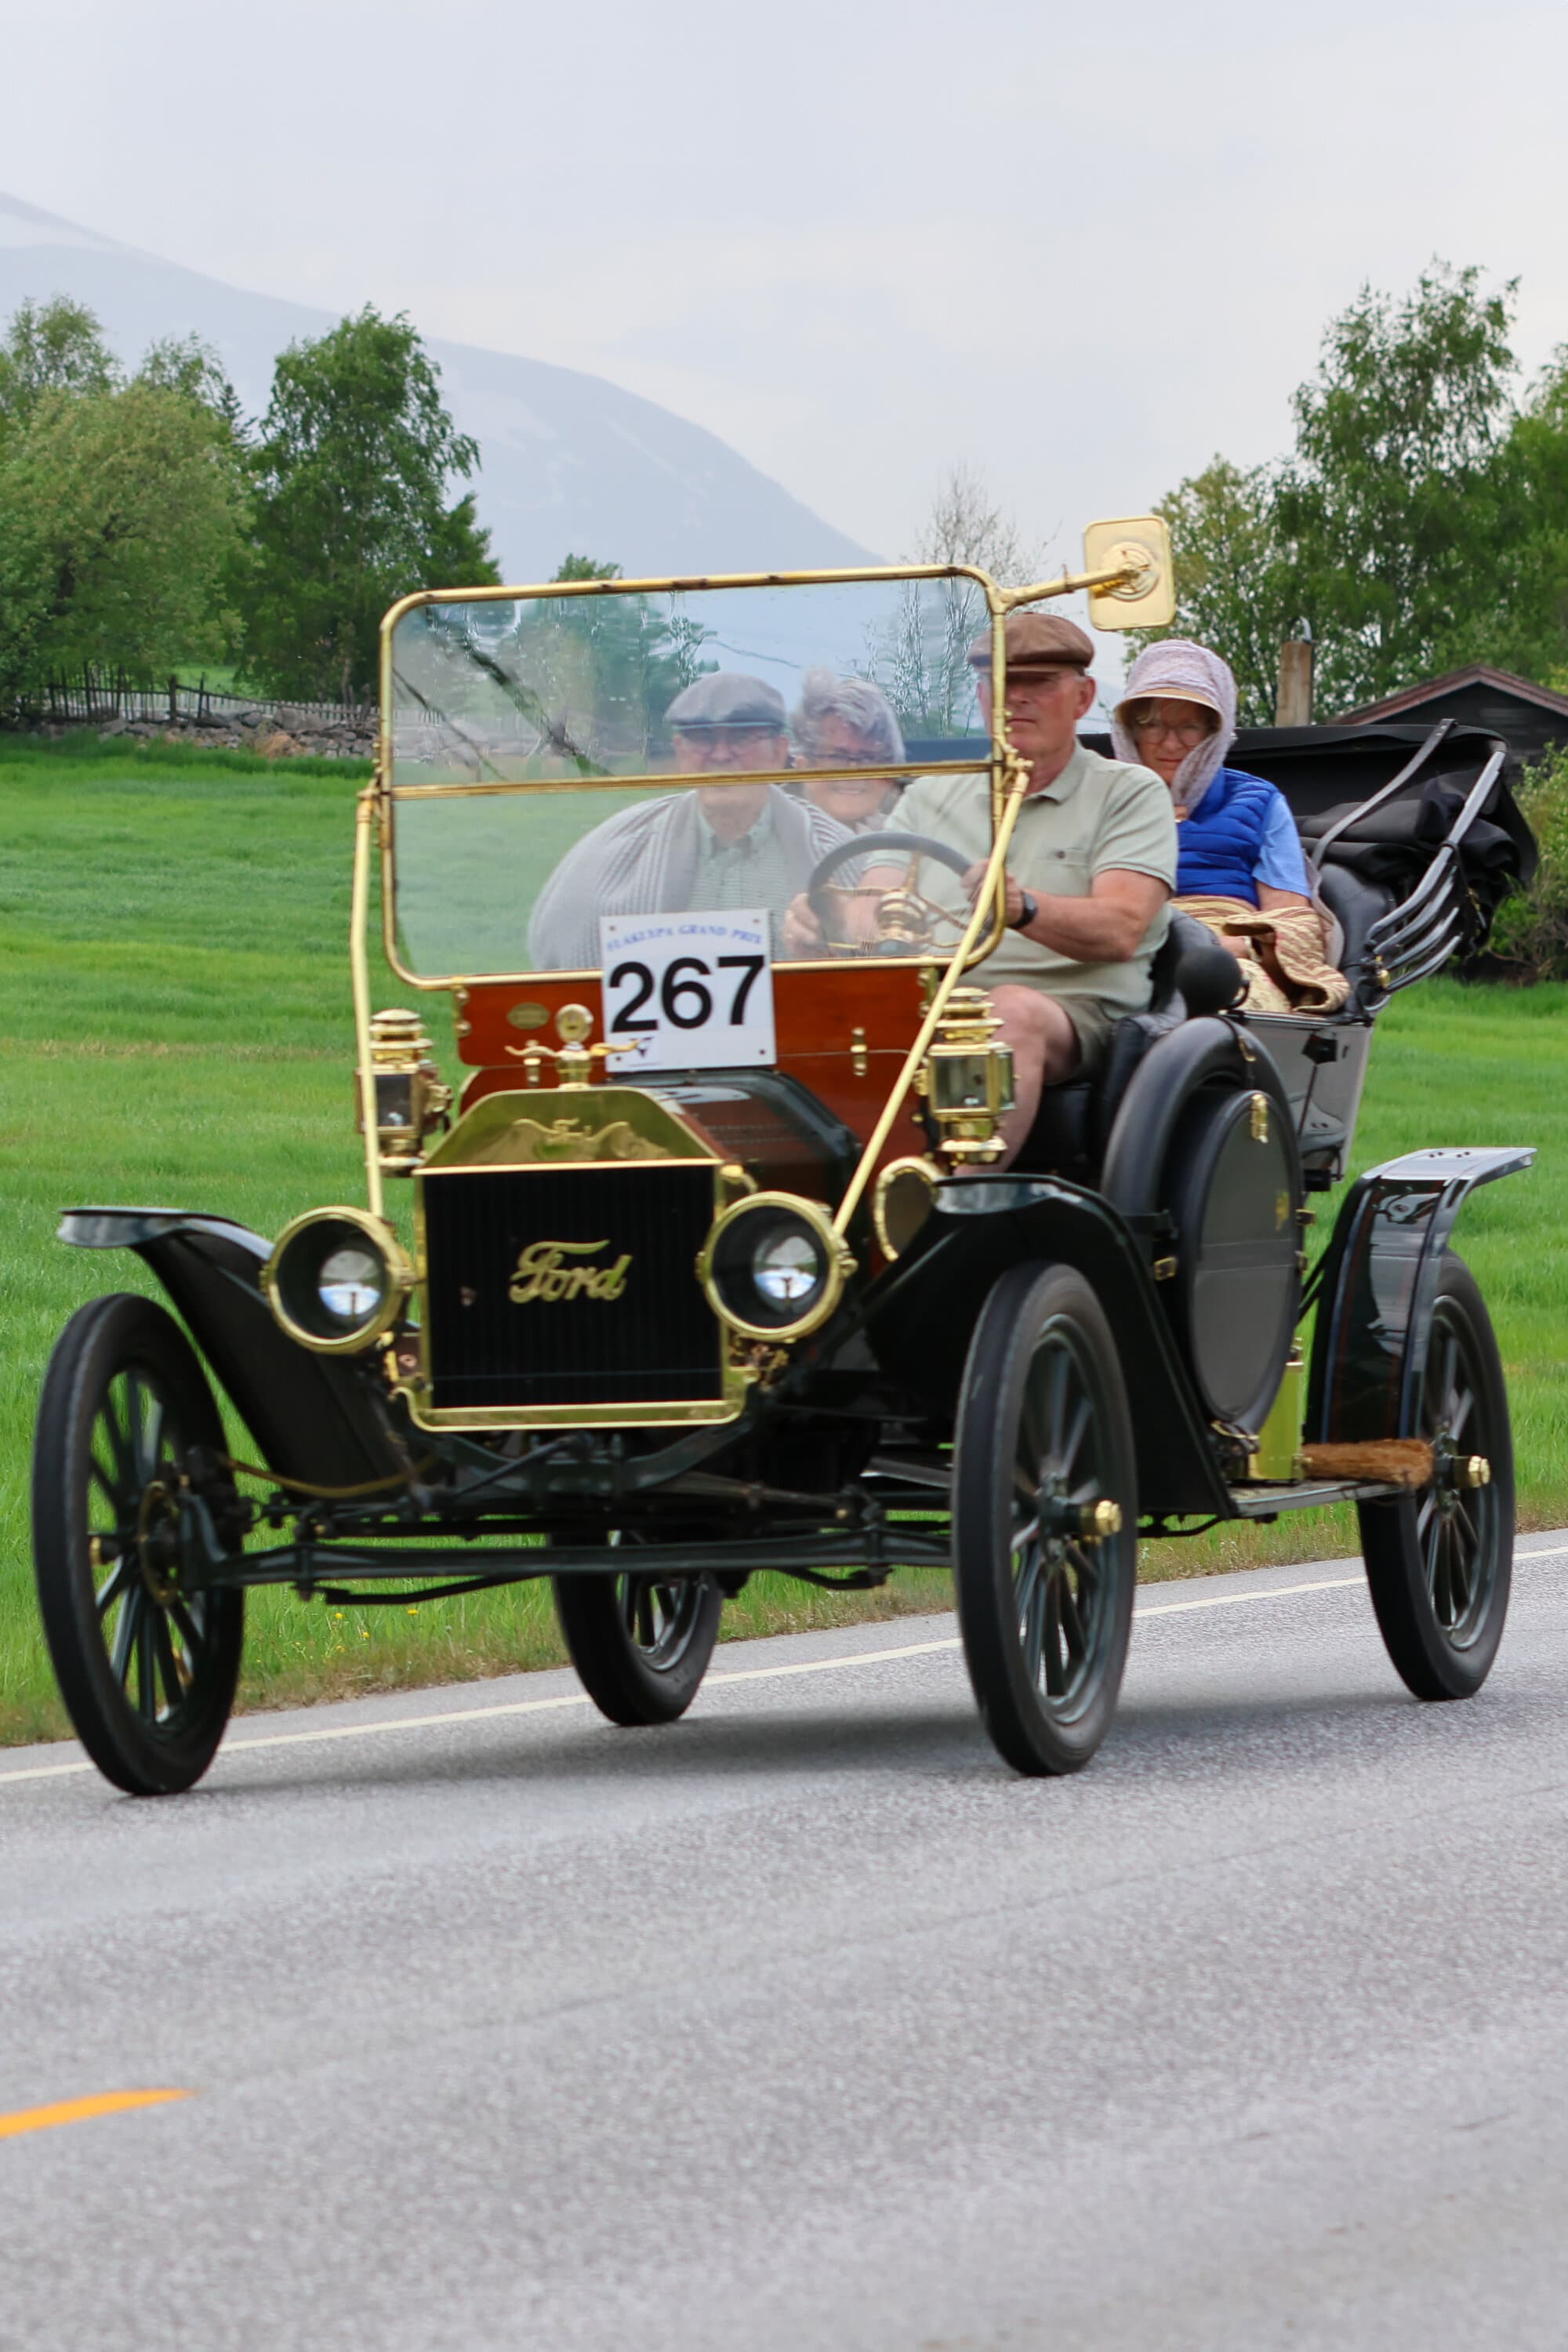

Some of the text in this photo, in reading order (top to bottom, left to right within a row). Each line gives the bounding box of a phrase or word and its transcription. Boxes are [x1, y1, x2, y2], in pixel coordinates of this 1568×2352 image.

[678, 924, 728, 936] GRAND
[608, 954, 765, 1033] 267
[508, 1239, 633, 1303] Ford
